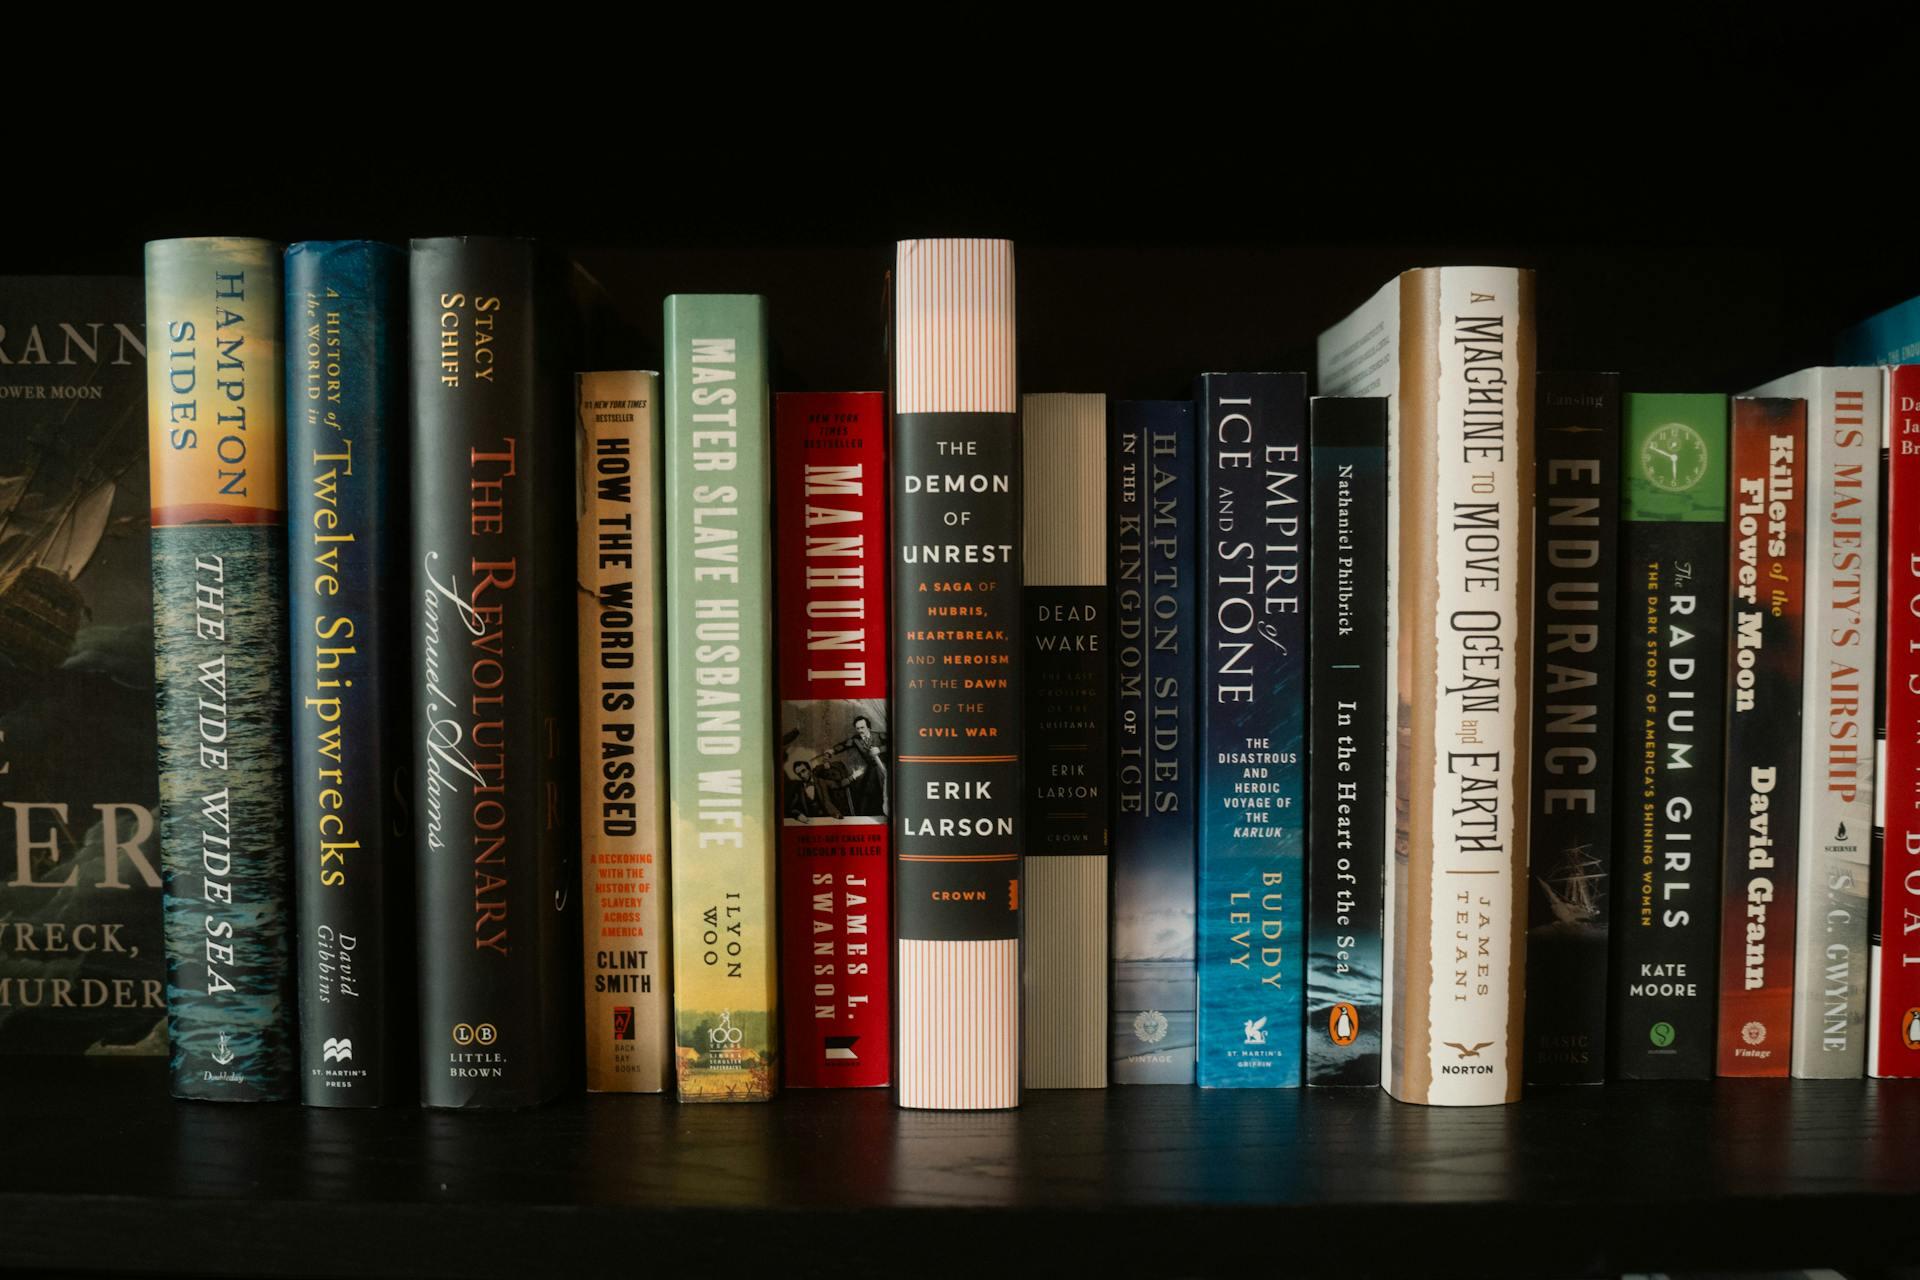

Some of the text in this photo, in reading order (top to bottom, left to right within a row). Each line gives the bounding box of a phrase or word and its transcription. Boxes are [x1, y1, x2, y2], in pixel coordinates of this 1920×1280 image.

[440, 292, 466, 388] SCHIFF
[474, 296, 500, 384] STACY
[307, 293, 321, 425] the WORLD in
[324, 287, 341, 430] A HISTORY of
[51, 386, 103, 399] MOON
[168, 320, 197, 450] SIDES
[215, 271, 248, 498] HAMPTON
[594, 400, 609, 409] NEW
[610, 400, 627, 409] YORK
[628, 400, 647, 409] TIMES
[1546, 392, 1604, 408] Lansing
[595, 414, 634, 422] BESTSELLER
[937, 442, 977, 455] THE
[905, 474, 1009, 493] DEMON
[944, 512, 971, 526] OF
[1768, 435, 1794, 617] Killers of the
[903, 545, 1013, 564] UNREST
[1218, 397, 1254, 704] ICE AND STONE
[1258, 444, 1299, 656] EMPIRE of
[1338, 464, 1353, 636] Nathaniel Philbrick
[804, 463, 866, 687] MANHUNT
[1445, 291, 1507, 854] A MACHINE TO MOVE OCEAN and EARTH
[691, 338, 743, 849] MASTER SLAVE HUSBAND WIFE
[918, 583, 996, 592] A SAGA OF
[1828, 390, 1864, 803] HIS MAJESTY'S AIRSHIP
[928, 606, 988, 618] HUBRIS,
[1039, 604, 1097, 622] DEAD
[1119, 432, 1142, 813] IN THE KINGDOM OF ICE
[1153, 431, 1179, 814] HAMPTON SIDES
[597, 438, 637, 837] HOW THE WORD IS PASSED
[907, 631, 1009, 641] HEARTBREAK,
[1035, 634, 1099, 652] WAKE
[1544, 459, 1600, 815] ENDURANCE
[305, 439, 360, 887] Twelve Shipwrecks
[906, 656, 1009, 665] AND HEROISM
[909, 679, 1008, 689] AT THE DAWN
[424, 551, 487, 850] Samuel Adams
[470, 437, 518, 956] THE REVOLUTIONARY
[933, 703, 984, 713] OF THE
[919, 727, 999, 737] CIVIL WAR
[1736, 478, 1777, 991] Flower Moon David Grann
[1246, 738, 1269, 749] THE
[1641, 562, 1659, 927] THE DARK STORY OF AMERICA'S SHINING WOMEN
[1662, 560, 1696, 929] The RADIUM GIRLS
[1218, 753, 1297, 764] DISASTROUS
[195, 554, 236, 997] THE WIDE WIDE SEA
[1051, 764, 1085, 777] ERIK
[1243, 768, 1269, 779] AND
[927, 781, 993, 800] ERIK
[1037, 786, 1098, 799] LARSON
[1235, 782, 1281, 794] HEROIC
[1223, 797, 1292, 809] VOYAGE OF
[904, 817, 1014, 836] LARSON
[1246, 812, 1269, 824] THE
[1047, 833, 1088, 842] CROWN
[1233, 826, 1283, 838] KARLUK
[1335, 701, 1357, 974] In the Heart of the Sea
[590, 854, 653, 864] A RECKONING
[599, 868, 644, 878] WITH THE
[595, 883, 651, 893] HISTORY OF
[931, 891, 988, 901] CROWN
[601, 898, 642, 908] SLAVERY
[604, 912, 641, 922] ACROSS
[601, 927, 644, 937] AMERICA
[703, 906, 718, 966] WOO
[726, 893, 742, 979] ILYON
[1230, 891, 1250, 970] LEVY
[1261, 871, 1283, 990] BUDDY
[812, 873, 836, 1020] SWANSON
[845, 874, 869, 1020] JAMES L.
[1455, 891, 1470, 1002] TEJANI
[1477, 896, 1491, 997] JAMES
[317, 925, 335, 1004] Gibbins
[339, 932, 359, 997] David
[597, 951, 648, 969] CLINT
[1823, 875, 1851, 1052] S. C. GWYNNE
[1640, 964, 1687, 977] KATE
[595, 975, 651, 993] SMITH
[1630, 983, 1697, 997] MOORE
[1128, 1055, 1173, 1063] VINTAGE
[1734, 1048, 1771, 1059] Vintage
[325, 1068, 367, 1077] MARTIN'S
[450, 1068, 503, 1078] BROWN
[1442, 1065, 1494, 1074] NORTON
